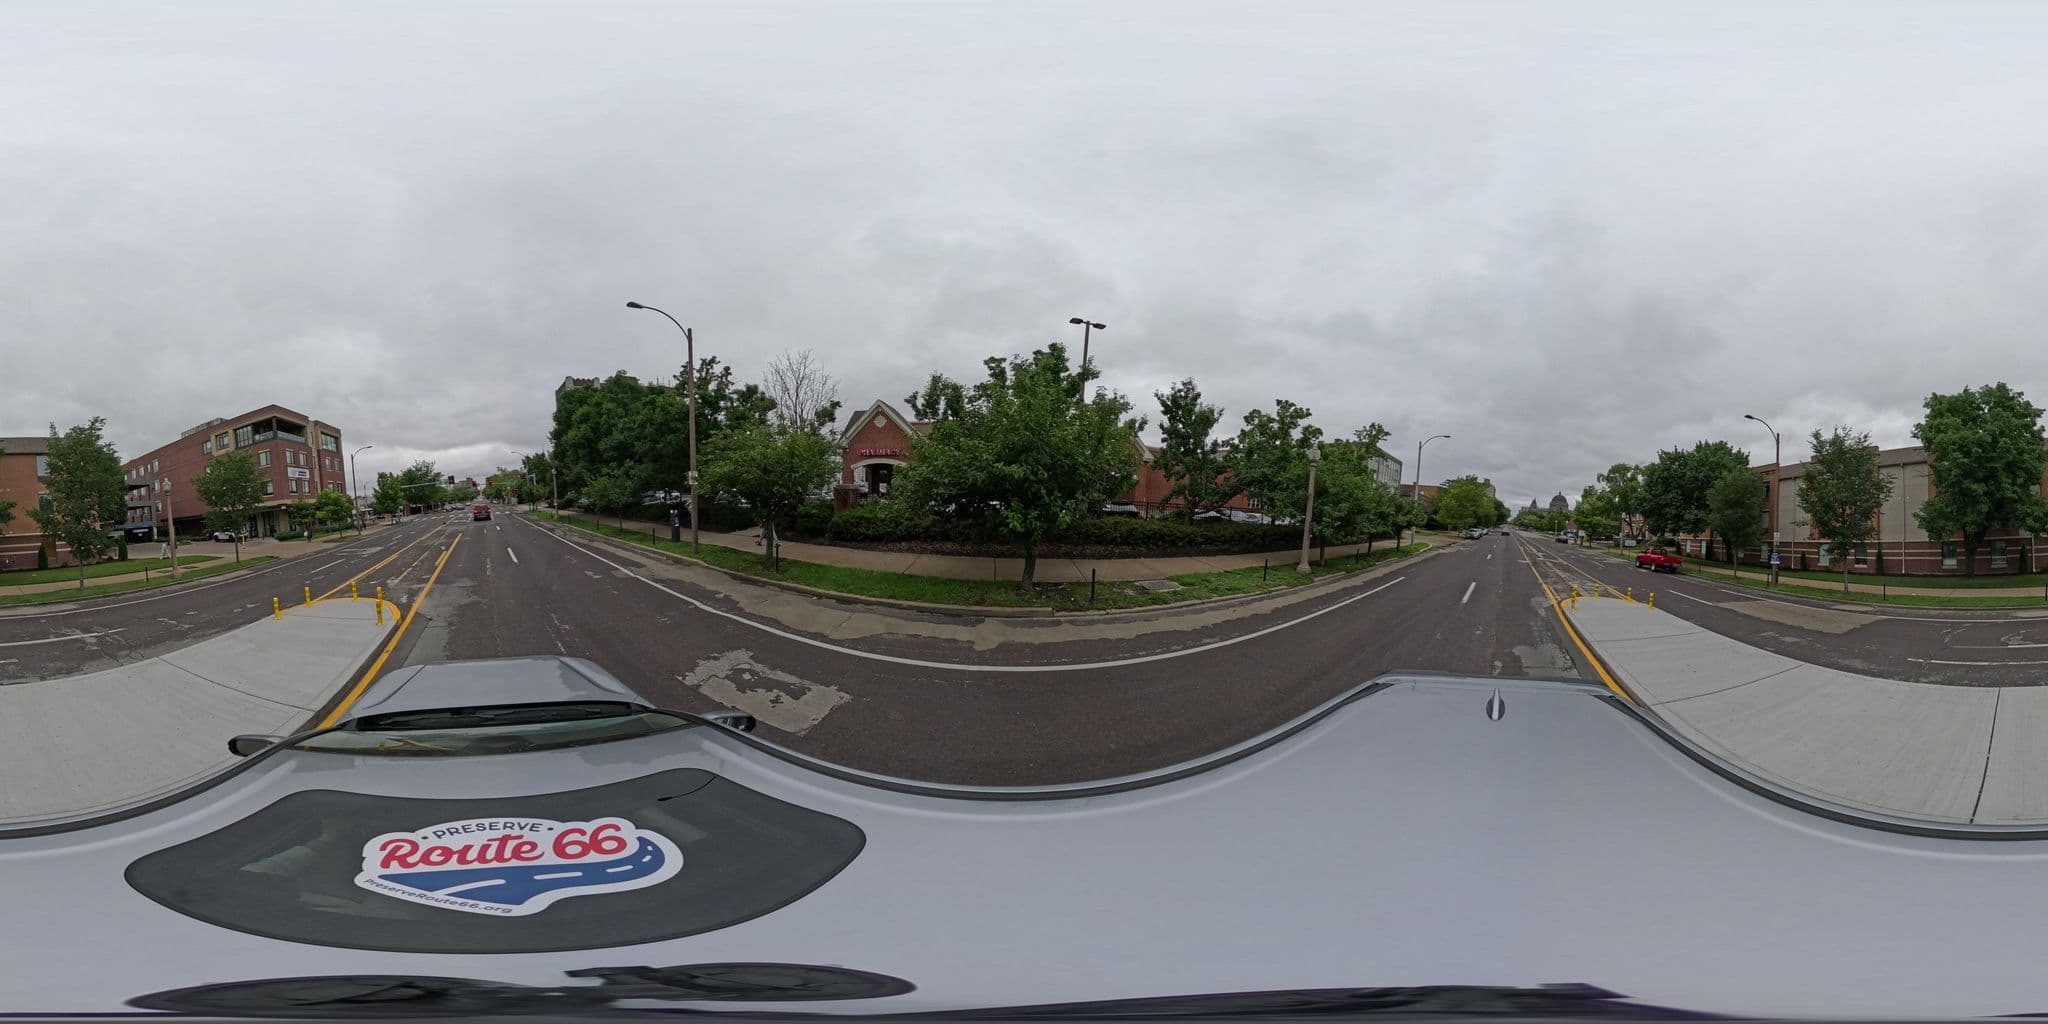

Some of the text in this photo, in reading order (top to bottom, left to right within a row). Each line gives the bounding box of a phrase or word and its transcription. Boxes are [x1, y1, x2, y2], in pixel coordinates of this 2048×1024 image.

[379, 823, 628, 869] Route 66
[432, 821, 543, 840] PRESERVE
[364, 877, 513, 914] PreserveRoute66.org
